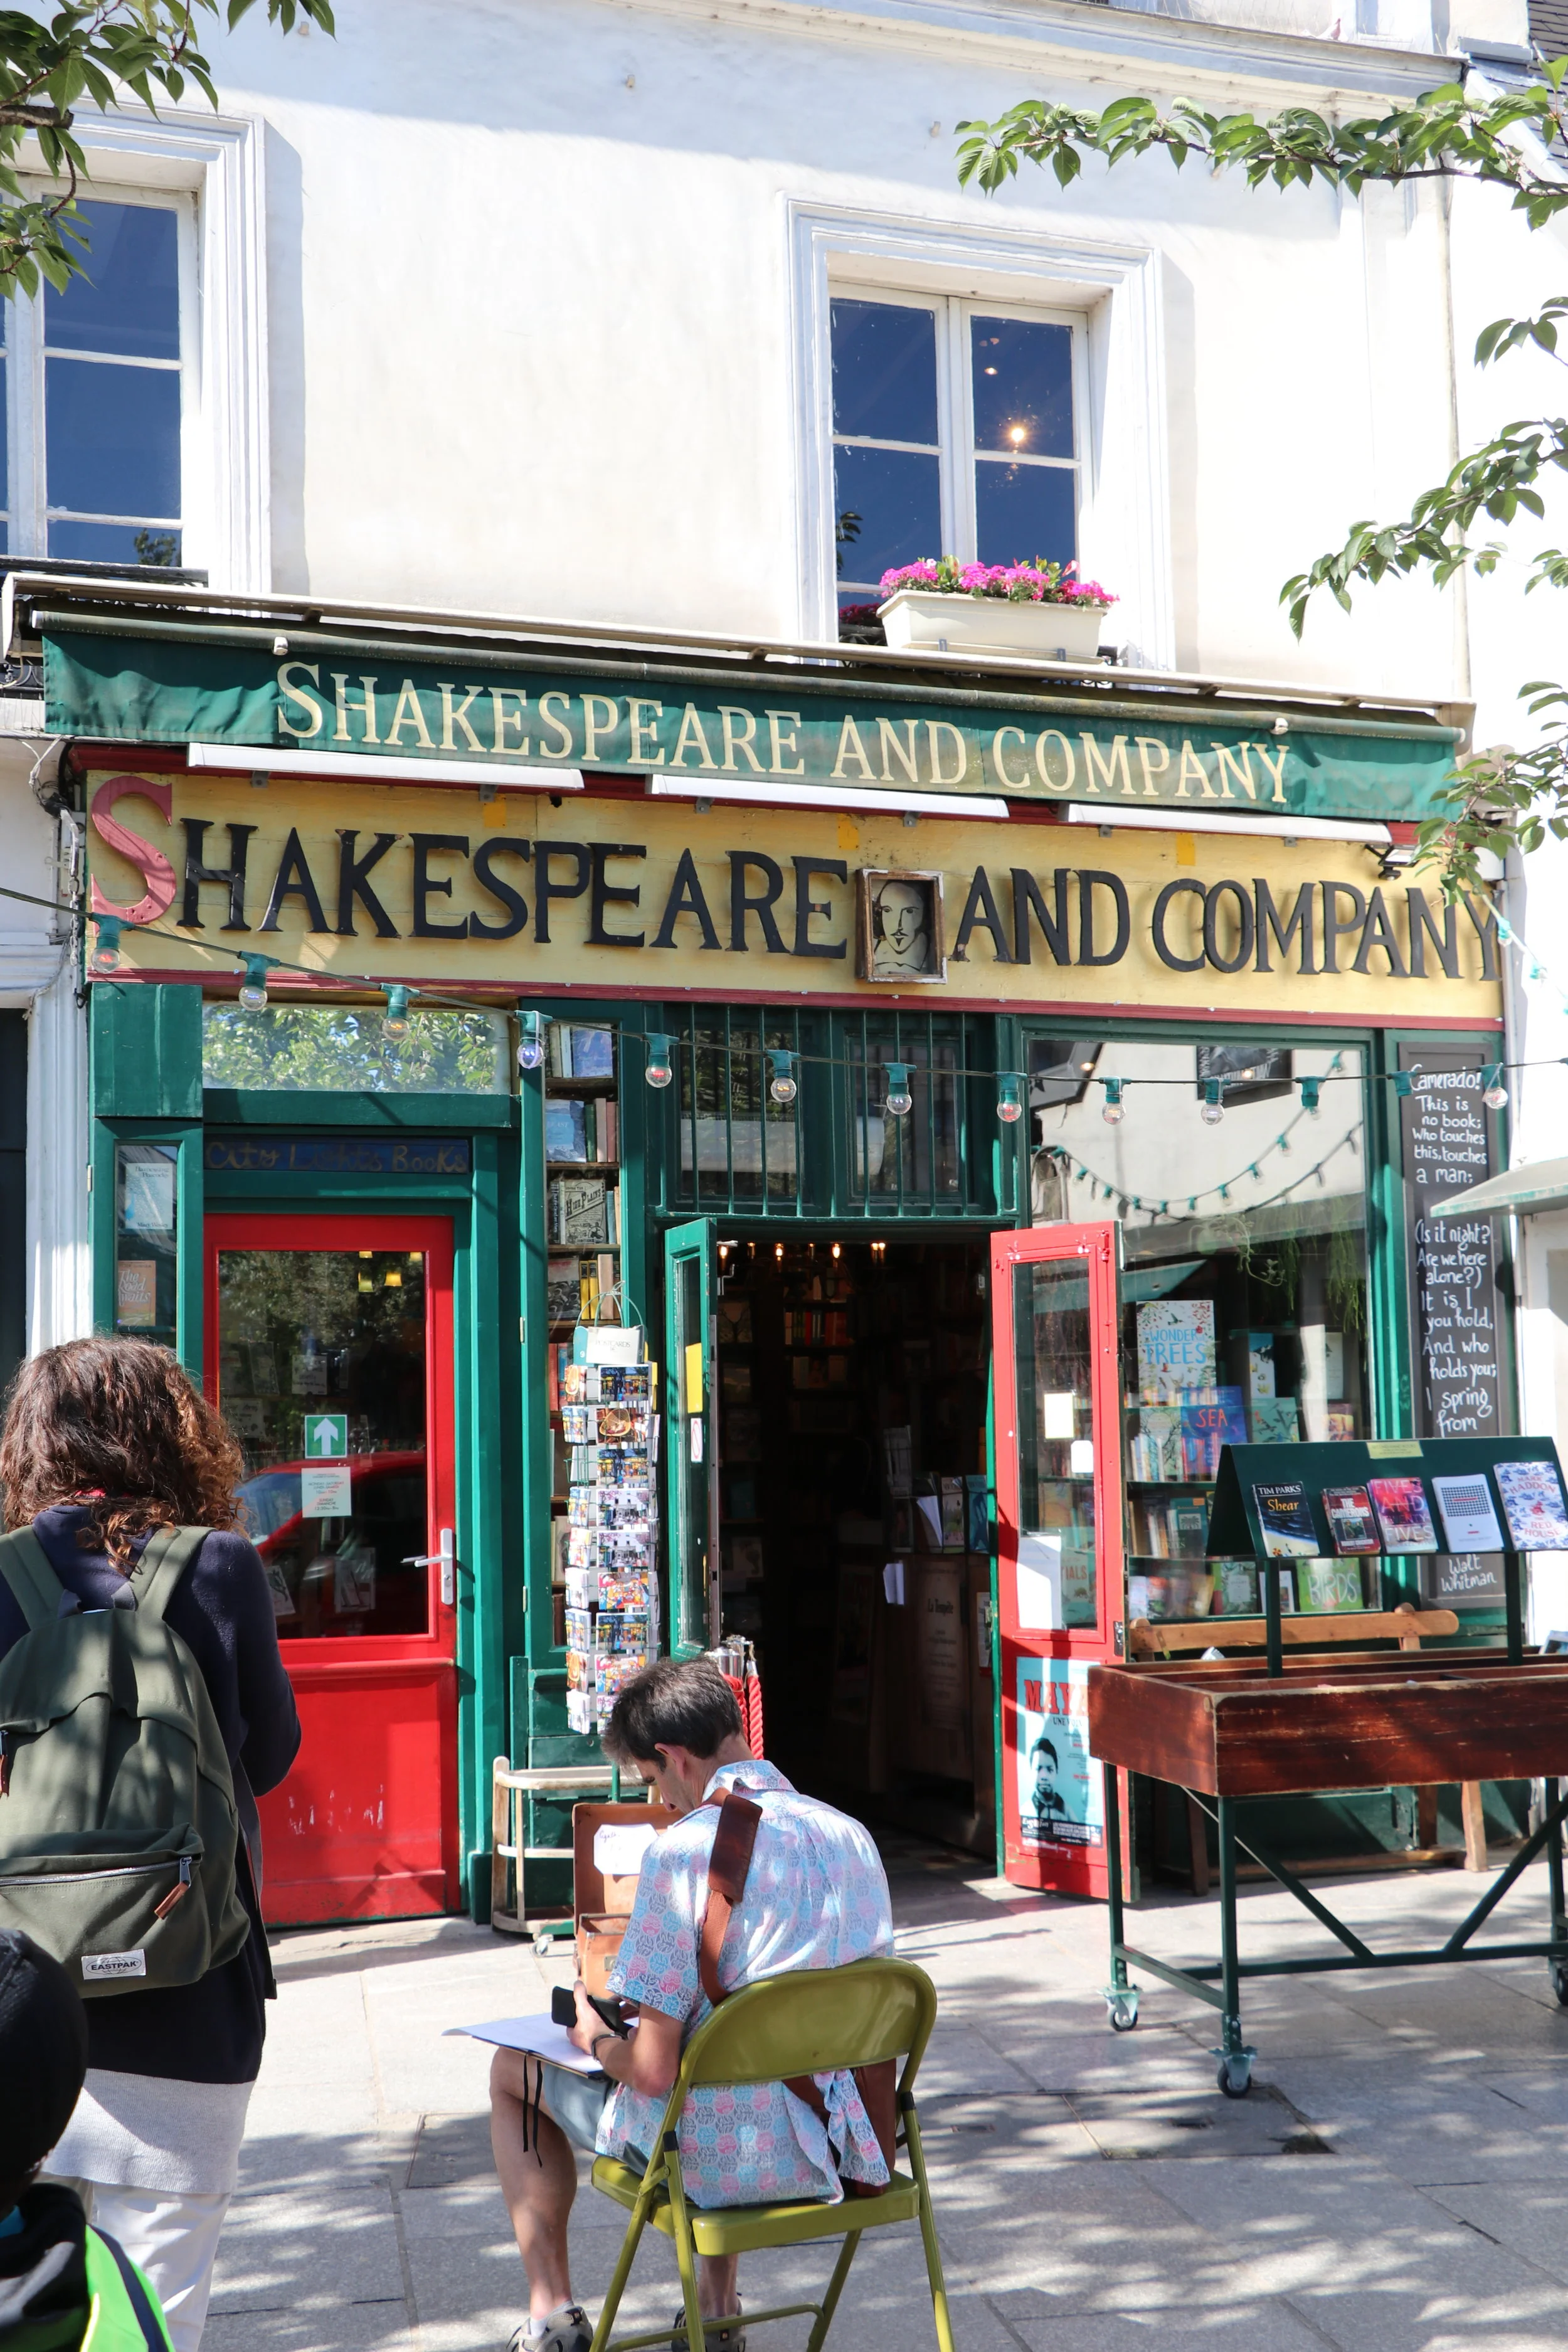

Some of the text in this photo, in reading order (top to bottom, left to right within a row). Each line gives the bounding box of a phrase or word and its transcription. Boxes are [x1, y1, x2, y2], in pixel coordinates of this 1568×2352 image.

[277, 662, 1290, 803] SHAKESPEARE AND COMPANY
[90, 775, 1503, 982] SHAKESPEARE AND COMPANY
[1409, 1063, 1482, 1091] Camerado!
[1414, 1094, 1469, 1113] This is
[1421, 1113, 1482, 1129] no book;
[1412, 1127, 1486, 1145] Who touches
[205, 1142, 280, 1170] City
[1416, 1167, 1474, 1184] a man;
[1414, 1218, 1491, 1251] (Is it night?
[1417, 1248, 1487, 1267] Are we here
[1425, 1266, 1483, 1289] alone?)
[1421, 1286, 1472, 1311] It is I
[1426, 1306, 1494, 1336] you hold,
[1150, 1328, 1198, 1342] WONDER
[1422, 1332, 1490, 1356] And who
[1143, 1342, 1207, 1365] TREES
[1429, 1357, 1468, 1380] holds
[1426, 1386, 1493, 1418] I spring
[1195, 1408, 1228, 1428] SEA
[1436, 1409, 1478, 1438] from
[1258, 1485, 1301, 1495] TIM PARKS
[1374, 1480, 1422, 1495] FIVES
[1509, 1482, 1556, 1494] HADDON
[1267, 1498, 1300, 1512] Shear
[1340, 1498, 1355, 1508] THE
[1381, 1495, 1424, 1513] AND
[1384, 1525, 1434, 1542] FIVES
[1523, 1527, 1562, 1538] HOUSE
[1531, 1520, 1552, 1529] RED
[1448, 1553, 1482, 1575] Walt
[1307, 1572, 1358, 1606] BIRDS
[1440, 1571, 1497, 1592] Whitman
[1053, 1717, 1066, 1727] UNE
[91, 1960, 137, 1971] EASTPAK
